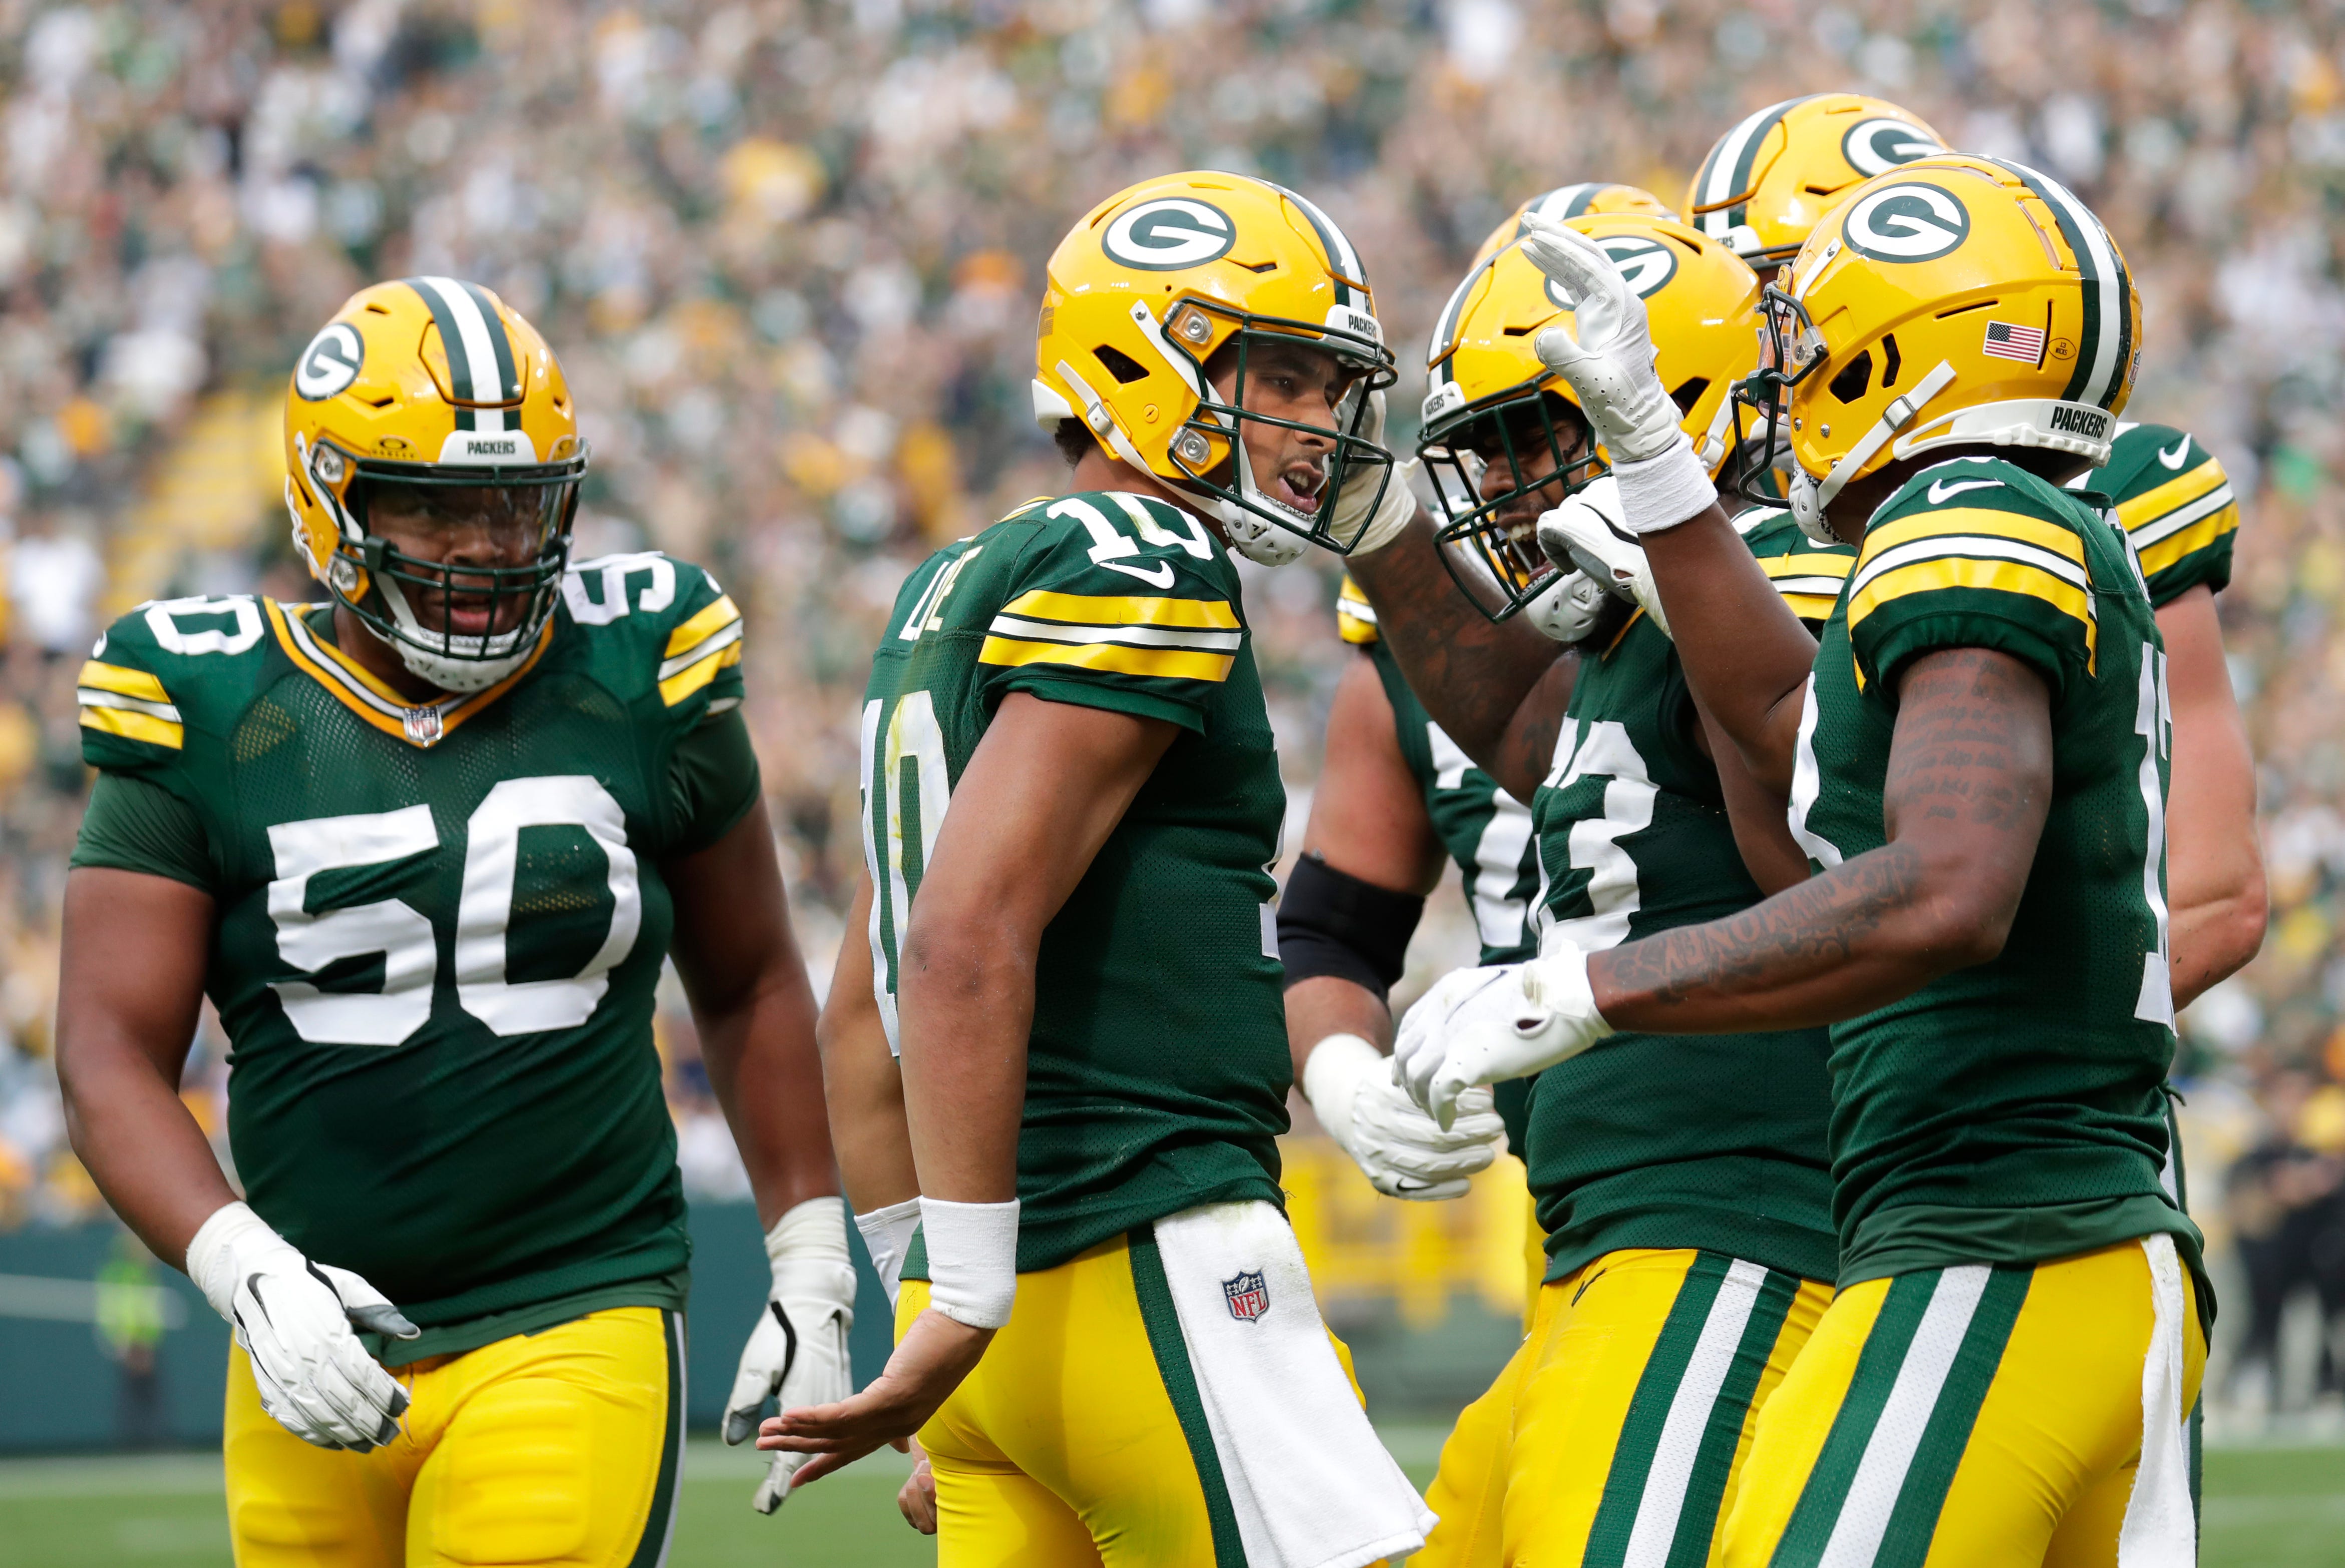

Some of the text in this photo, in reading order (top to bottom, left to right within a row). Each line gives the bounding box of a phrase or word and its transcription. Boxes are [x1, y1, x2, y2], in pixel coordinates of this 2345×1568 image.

[1107, 199, 1228, 265] G
[1847, 185, 1962, 257] G
[296, 323, 360, 399] G
[467, 440, 516, 454] PACKERS
[2050, 406, 2108, 439] PACKERS
[1046, 491, 1214, 564] 10
[411, 719, 438, 738] NFL
[266, 774, 642, 1047] 50
[1230, 1290, 1266, 1317] NFL
